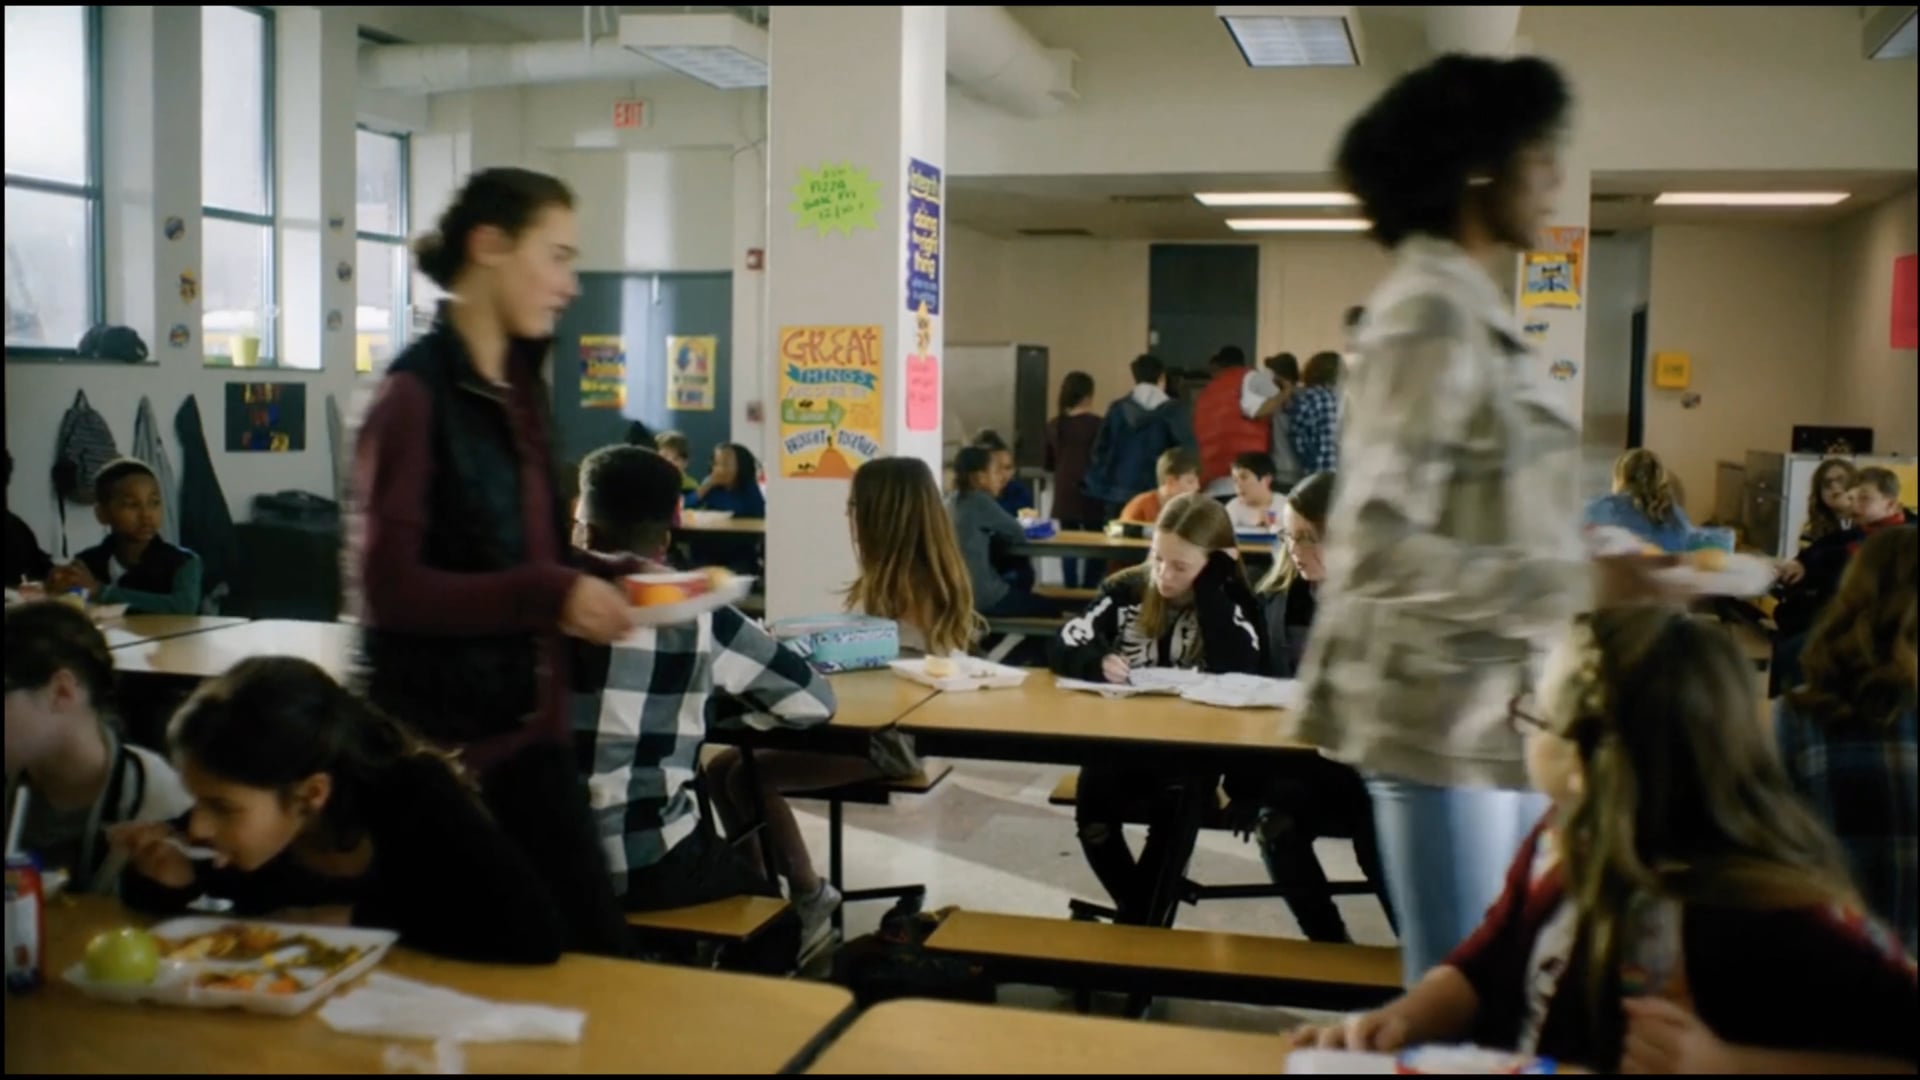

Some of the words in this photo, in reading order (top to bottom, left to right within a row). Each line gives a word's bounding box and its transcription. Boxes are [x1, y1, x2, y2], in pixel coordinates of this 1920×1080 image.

[614, 102, 643, 127] EXIT
[810, 179, 847, 194] PIZZA
[782, 328, 878, 367] GREAT
[799, 369, 868, 385] THINGS
